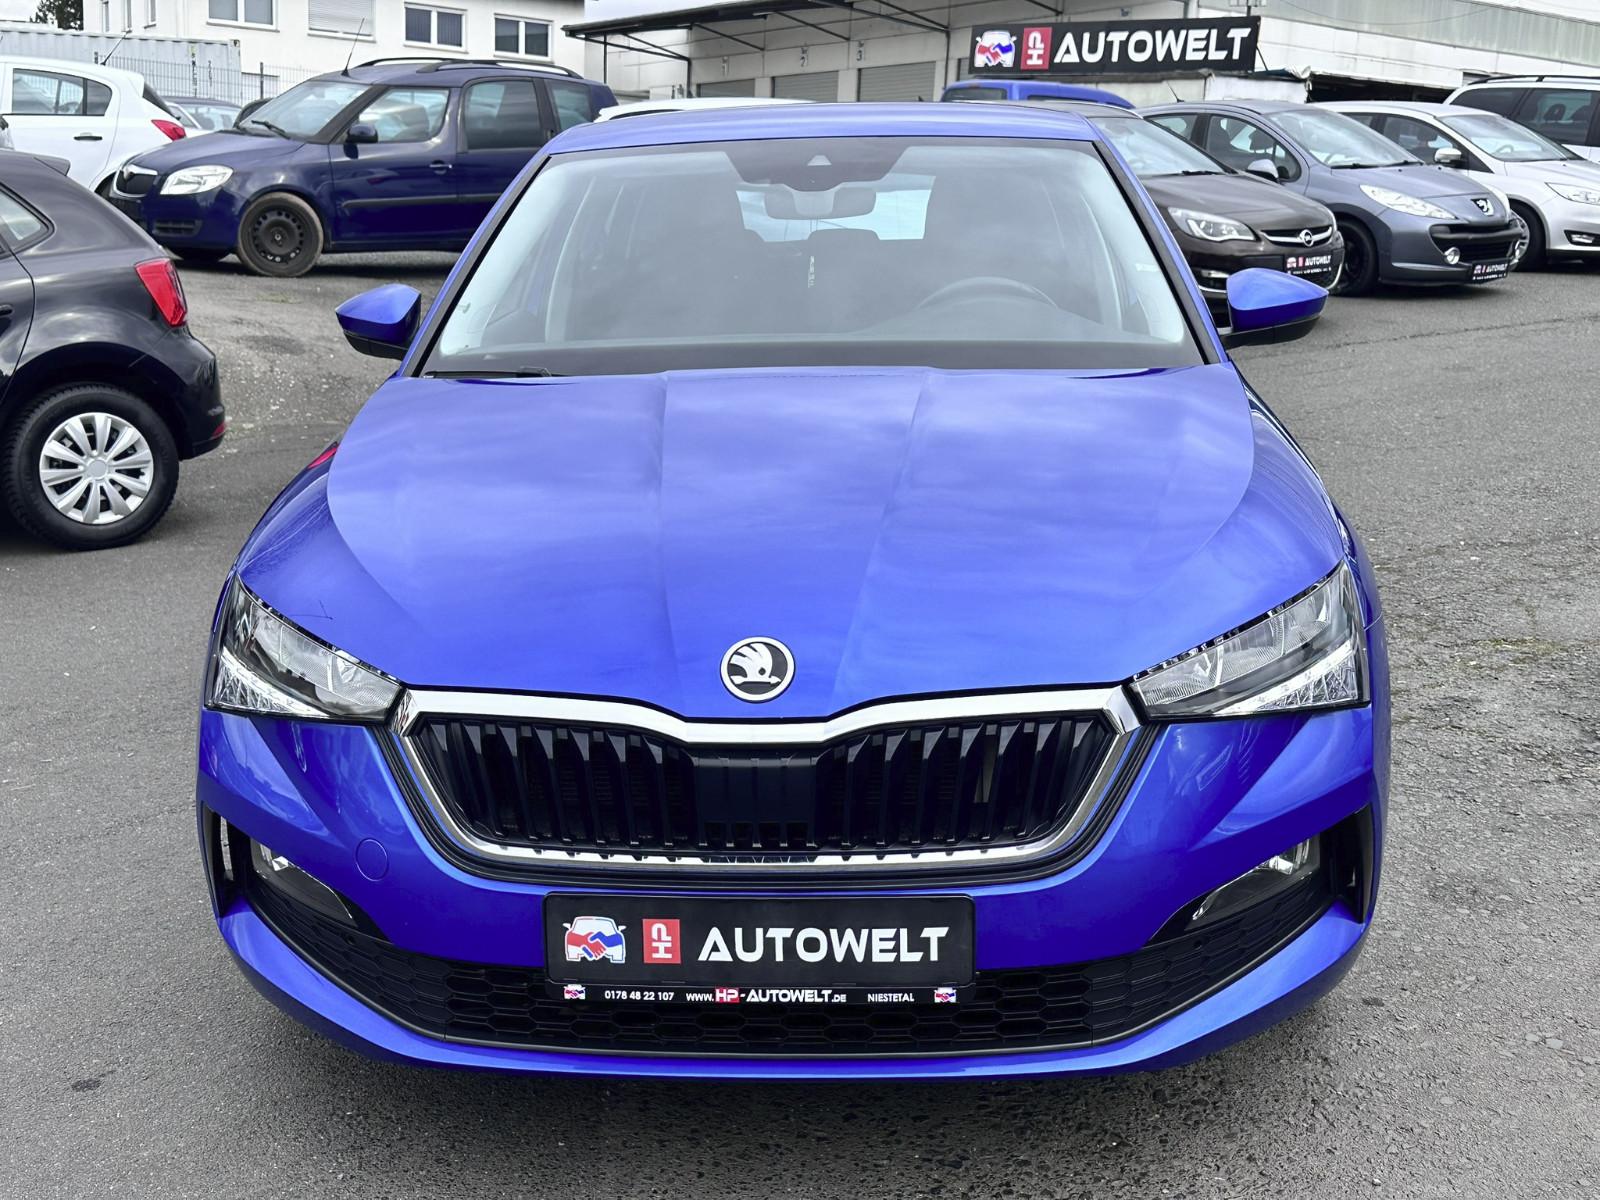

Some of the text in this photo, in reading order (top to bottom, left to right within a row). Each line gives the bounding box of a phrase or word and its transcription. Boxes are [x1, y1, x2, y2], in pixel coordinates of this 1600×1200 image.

[1026, 27, 1252, 66] HP AUTOWELT
[651, 922, 950, 963] HP AUTOWELT
[604, 990, 628, 1000] 0178
[629, 991, 642, 1000] 48
[643, 991, 655, 1001] 22
[657, 991, 675, 1001] 107
[867, 992, 915, 1003] NIESTETAL
